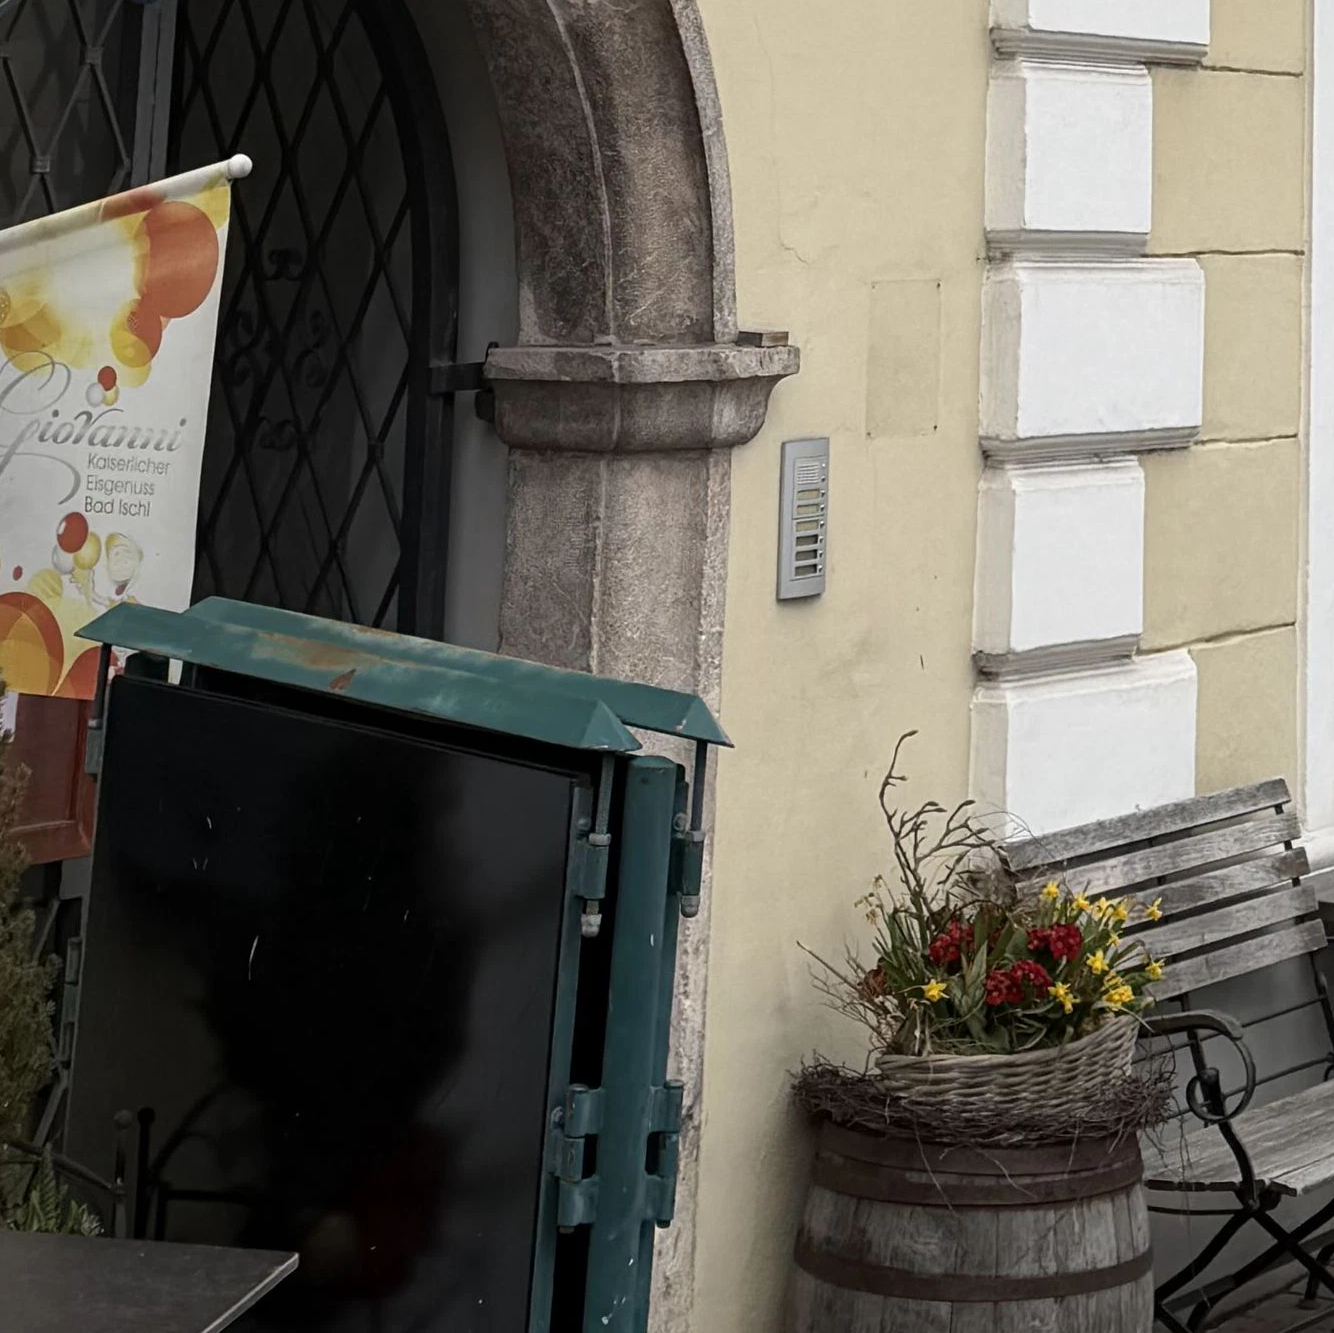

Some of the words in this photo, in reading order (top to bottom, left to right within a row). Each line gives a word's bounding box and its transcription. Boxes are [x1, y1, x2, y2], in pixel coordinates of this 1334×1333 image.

[87, 452, 171, 476] Kaiserlicher
[86, 474, 155, 497] Eisgenuss
[84, 496, 114, 515] Bad
[118, 498, 151, 517] Ischl
